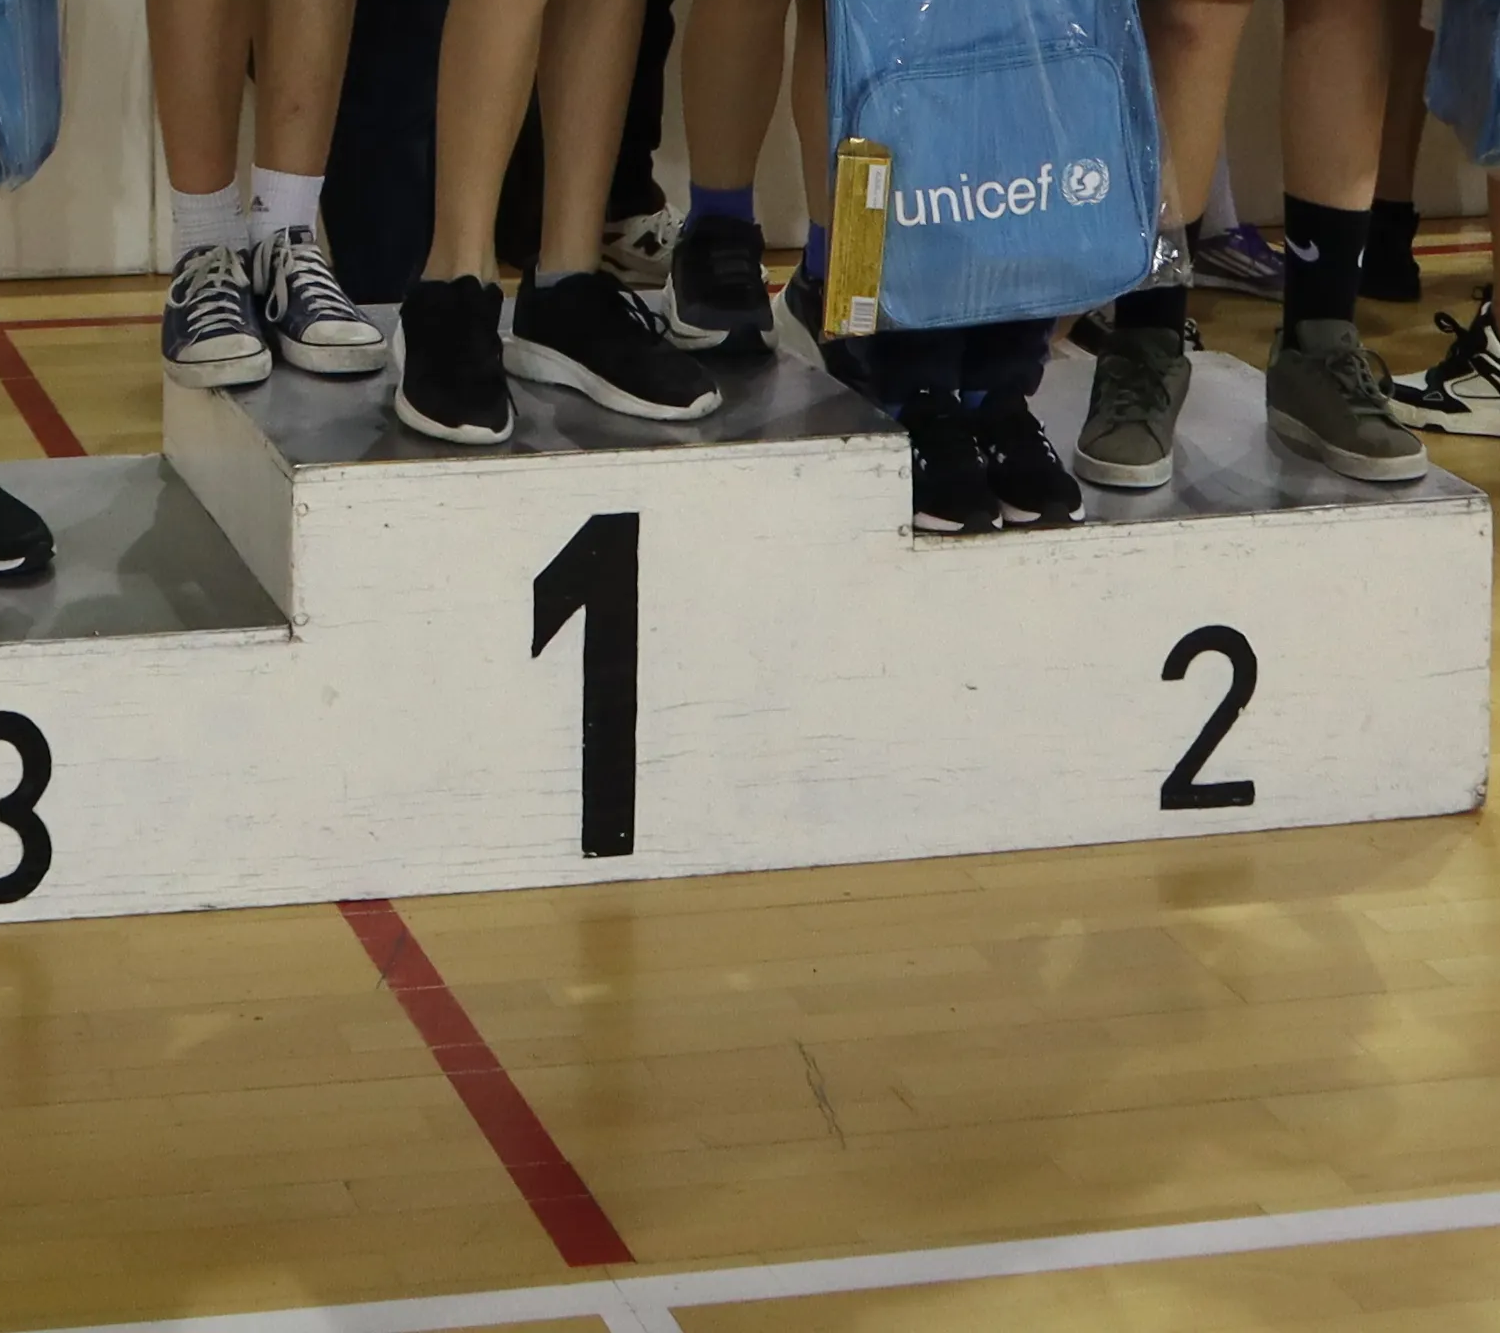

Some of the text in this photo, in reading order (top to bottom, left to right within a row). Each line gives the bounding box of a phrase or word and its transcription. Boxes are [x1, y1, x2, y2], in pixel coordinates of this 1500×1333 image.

[894, 163, 1053, 227] unicef
[531, 512, 640, 858] 1
[1160, 624, 1258, 811] 2
